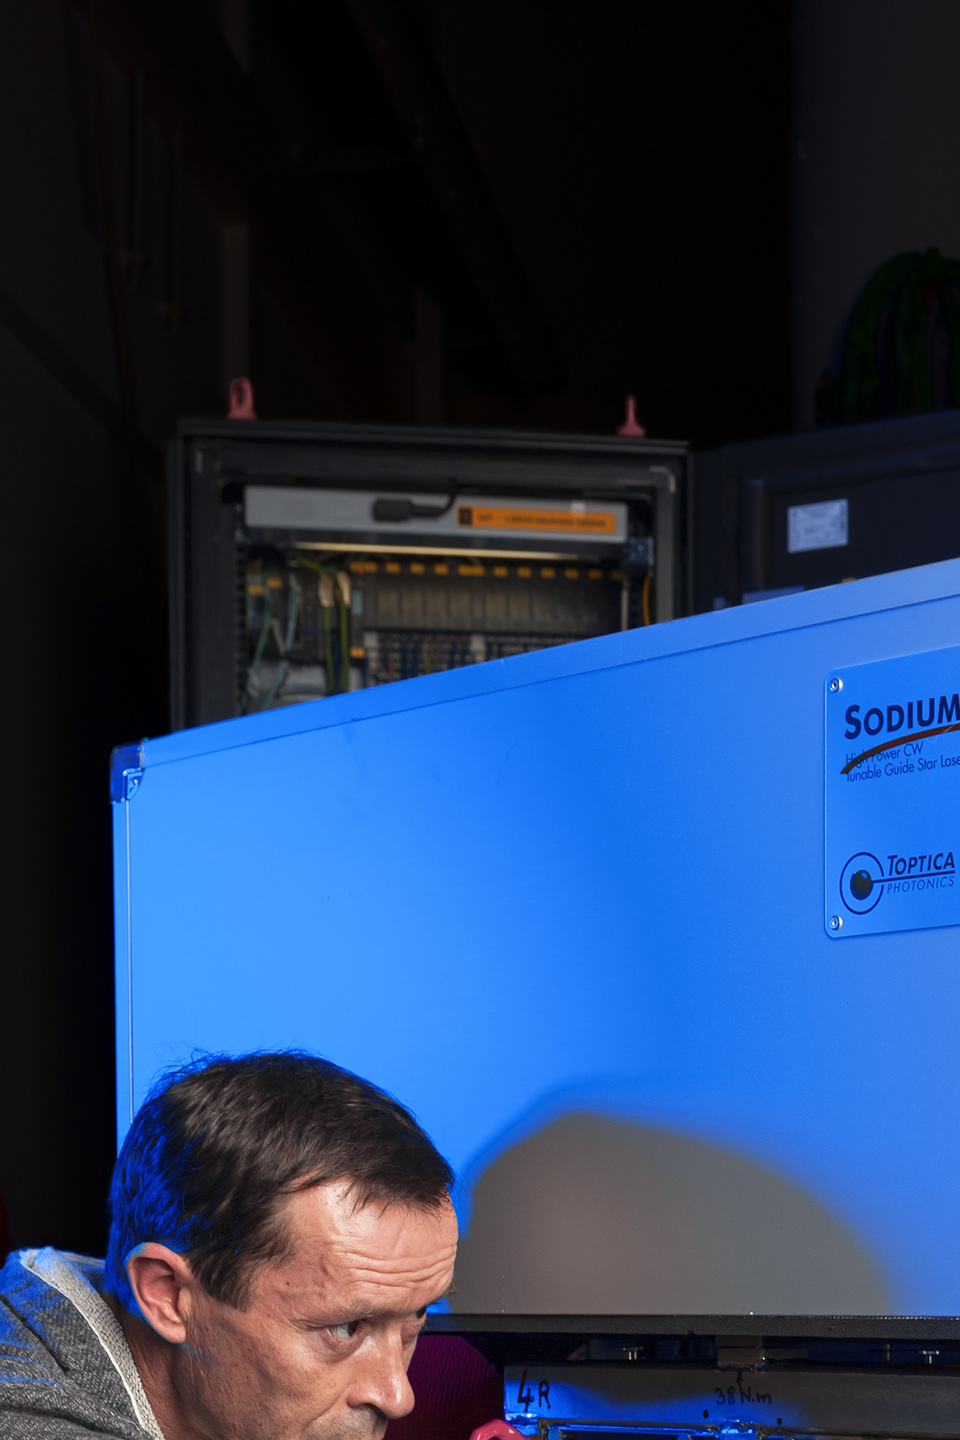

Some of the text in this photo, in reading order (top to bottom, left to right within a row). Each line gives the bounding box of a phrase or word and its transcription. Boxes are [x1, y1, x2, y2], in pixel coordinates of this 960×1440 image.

[904, 742, 924, 757] CW
[884, 758, 915, 776] Guide
[917, 757, 938, 771] Star
[887, 852, 955, 876] TOPTICA
[887, 876, 955, 894] PHOTONICS
[518, 1368, 551, 1413] 4R
